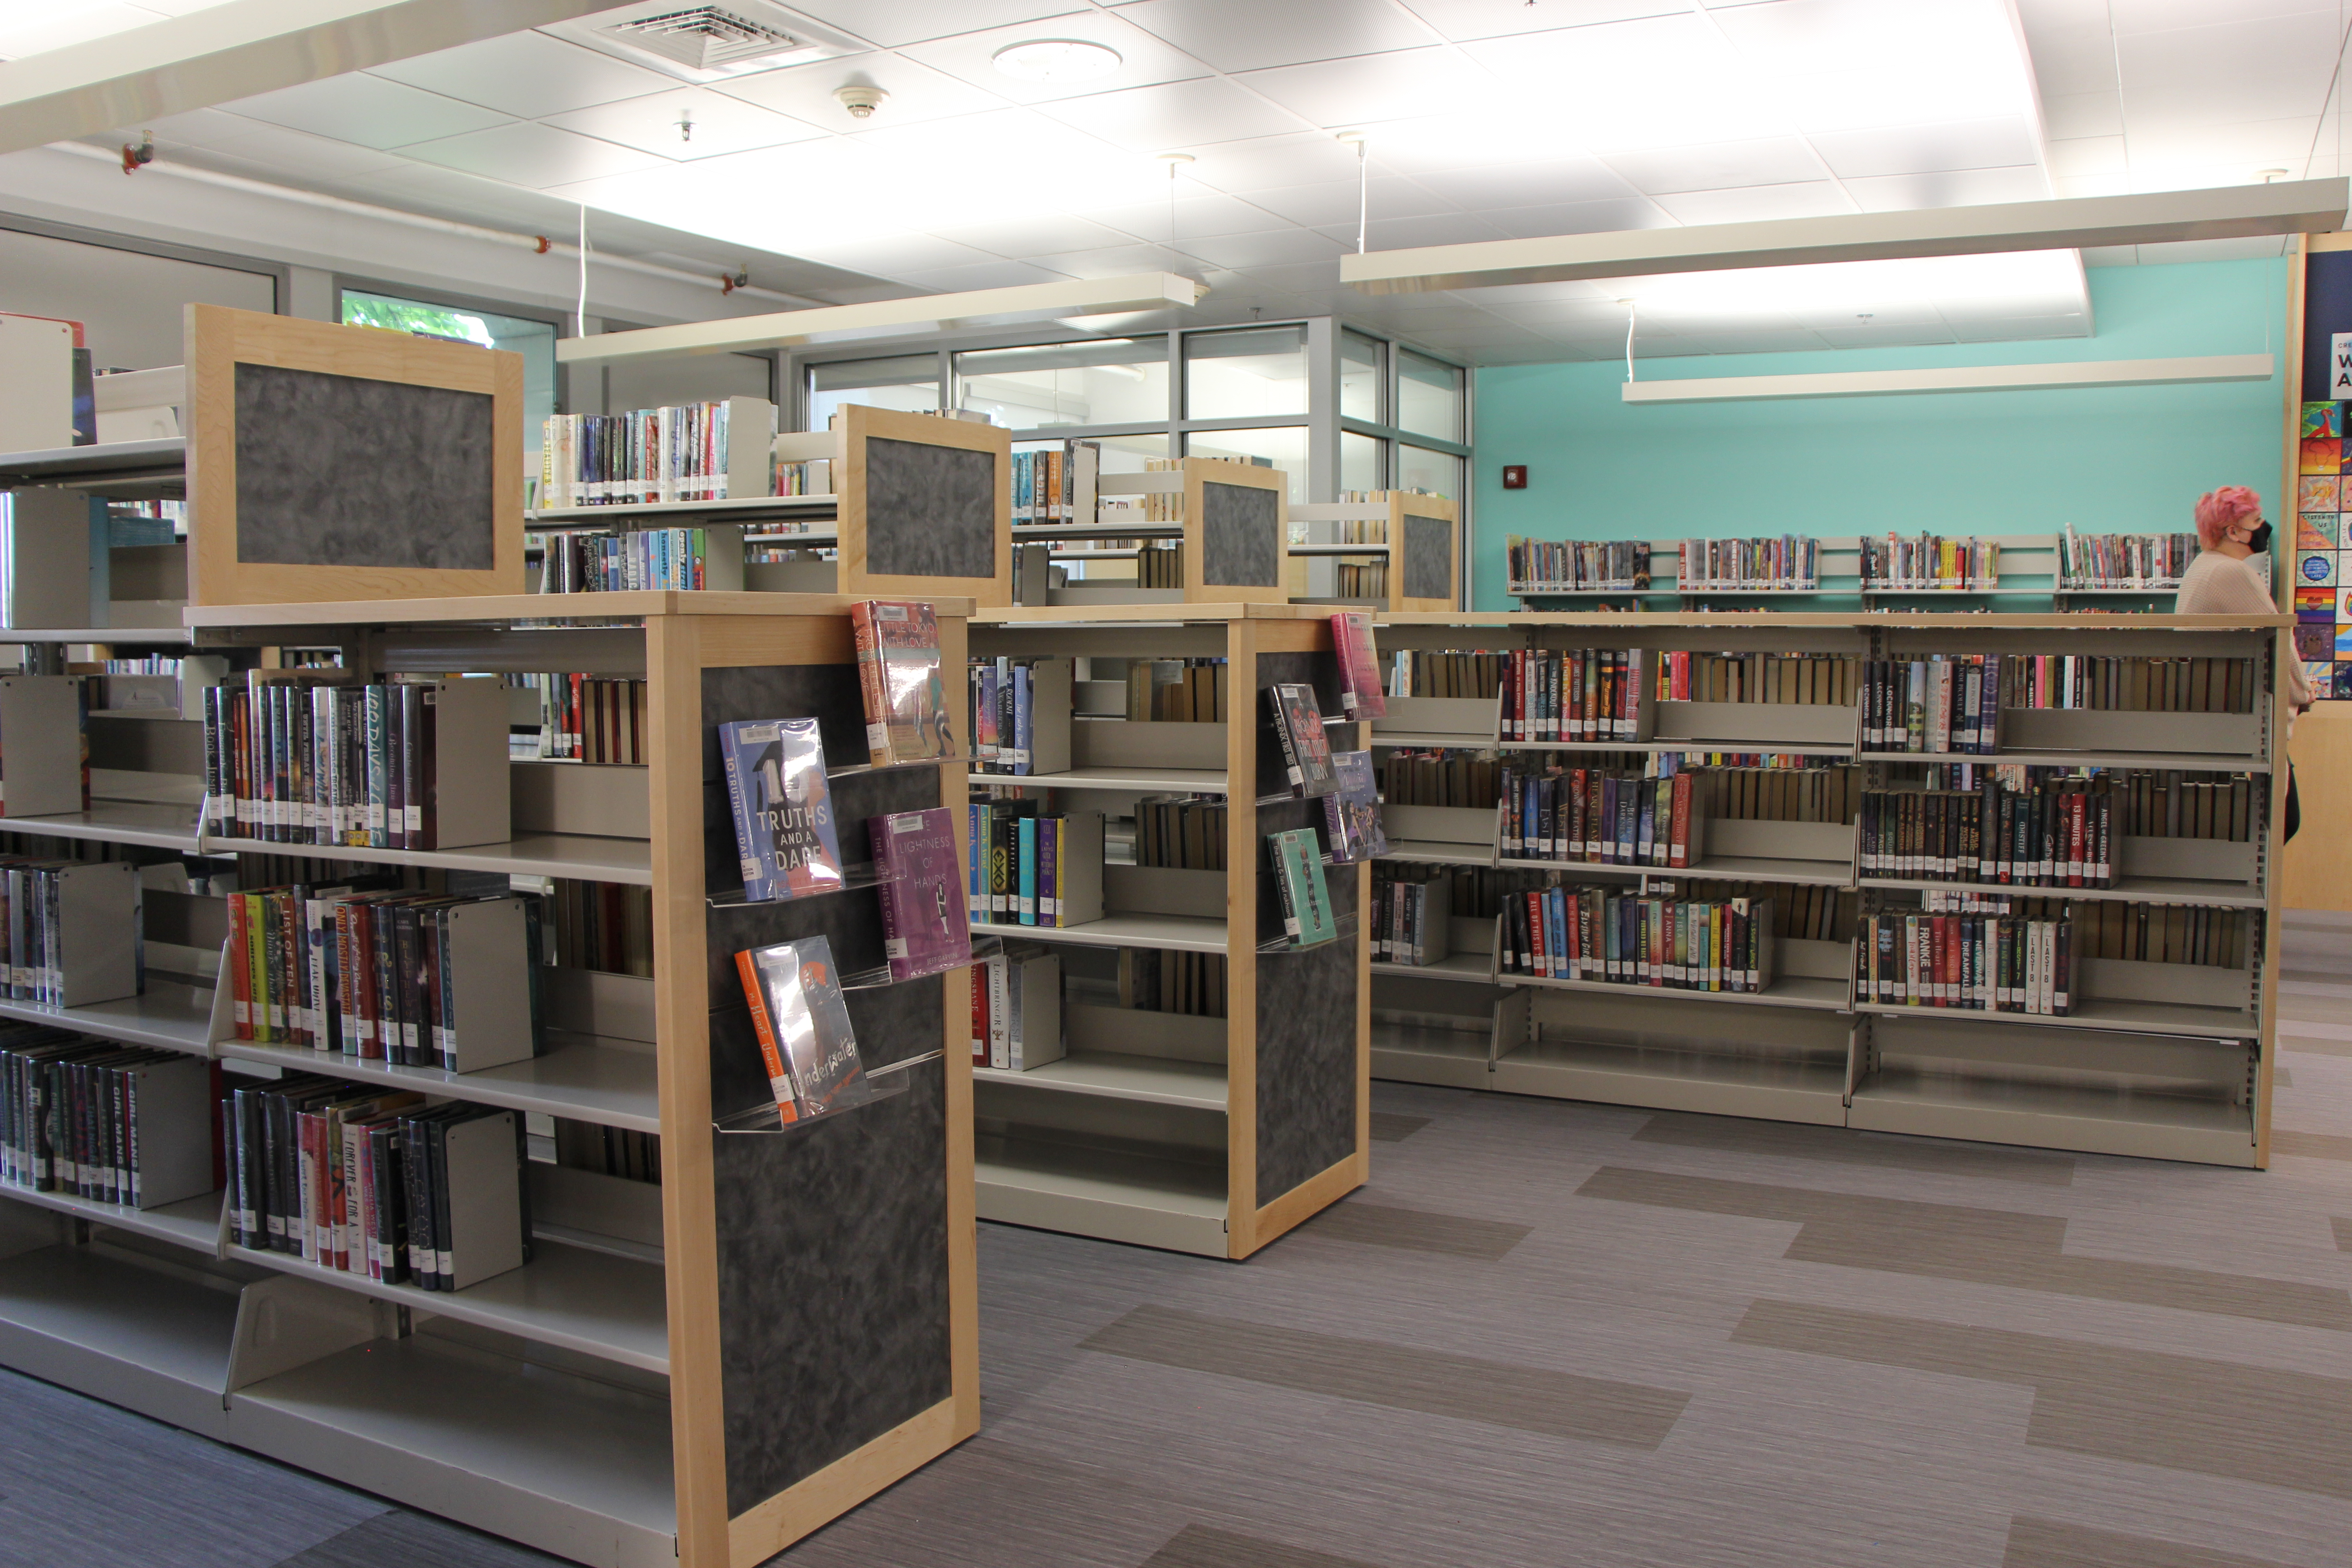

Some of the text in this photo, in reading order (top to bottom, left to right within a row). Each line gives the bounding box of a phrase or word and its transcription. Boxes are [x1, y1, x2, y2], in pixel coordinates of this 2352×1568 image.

[882, 637, 927, 647] WITH LOVE
[855, 629, 869, 692] WITH LOVE
[368, 691, 381, 776] 100 DAYS
[1294, 718, 1321, 734] PHOENIX
[206, 724, 216, 758] BOOK
[1274, 718, 1294, 766] PHOENIX FIRST MUST
[1298, 739, 1328, 757] FIRST MUST
[726, 757, 735, 771] 10
[1310, 763, 1328, 780] BURN
[728, 772, 741, 815] TRUTHS
[1590, 781, 1599, 808] HEART
[756, 805, 828, 832] TRUTHS
[1539, 809, 1551, 833] EAST
[1558, 803, 1568, 832] WEST
[1619, 801, 1627, 839] DARKNESS
[1627, 807, 1635, 834] BEAUTY
[2072, 804, 2081, 846] 13 MINUTES
[780, 832, 813, 846] AND A
[899, 836, 950, 854] LIGHTNESS
[2018, 821, 2026, 853] MASTIFF
[775, 846, 821, 871] DARE
[923, 857, 933, 868] OF
[874, 837, 882, 853] THE
[885, 911, 893, 923] OF
[914, 873, 947, 889] HANDS
[283, 910, 291, 935] LIST
[335, 907, 347, 932] ONLY
[1580, 910, 1590, 942] ELYSIUM
[285, 940, 292, 958] OF
[338, 936, 348, 971] MOSTLY
[926, 952, 957, 965] JEFF GARVIN
[1918, 927, 1931, 967] FRANKIE
[1961, 941, 1970, 988] DREAMFALL
[2016, 972, 2020, 980] 7
[2030, 974, 2034, 982] 8
[2044, 975, 2048, 983] 8
[750, 1004, 768, 1036] Heart
[792, 1037, 857, 1097] Underwater
[115, 1123, 124, 1164] MANS
[130, 1126, 138, 1167] MANS
[345, 1141, 356, 1182] FOREVER
[347, 1199, 358, 1217] FOR
